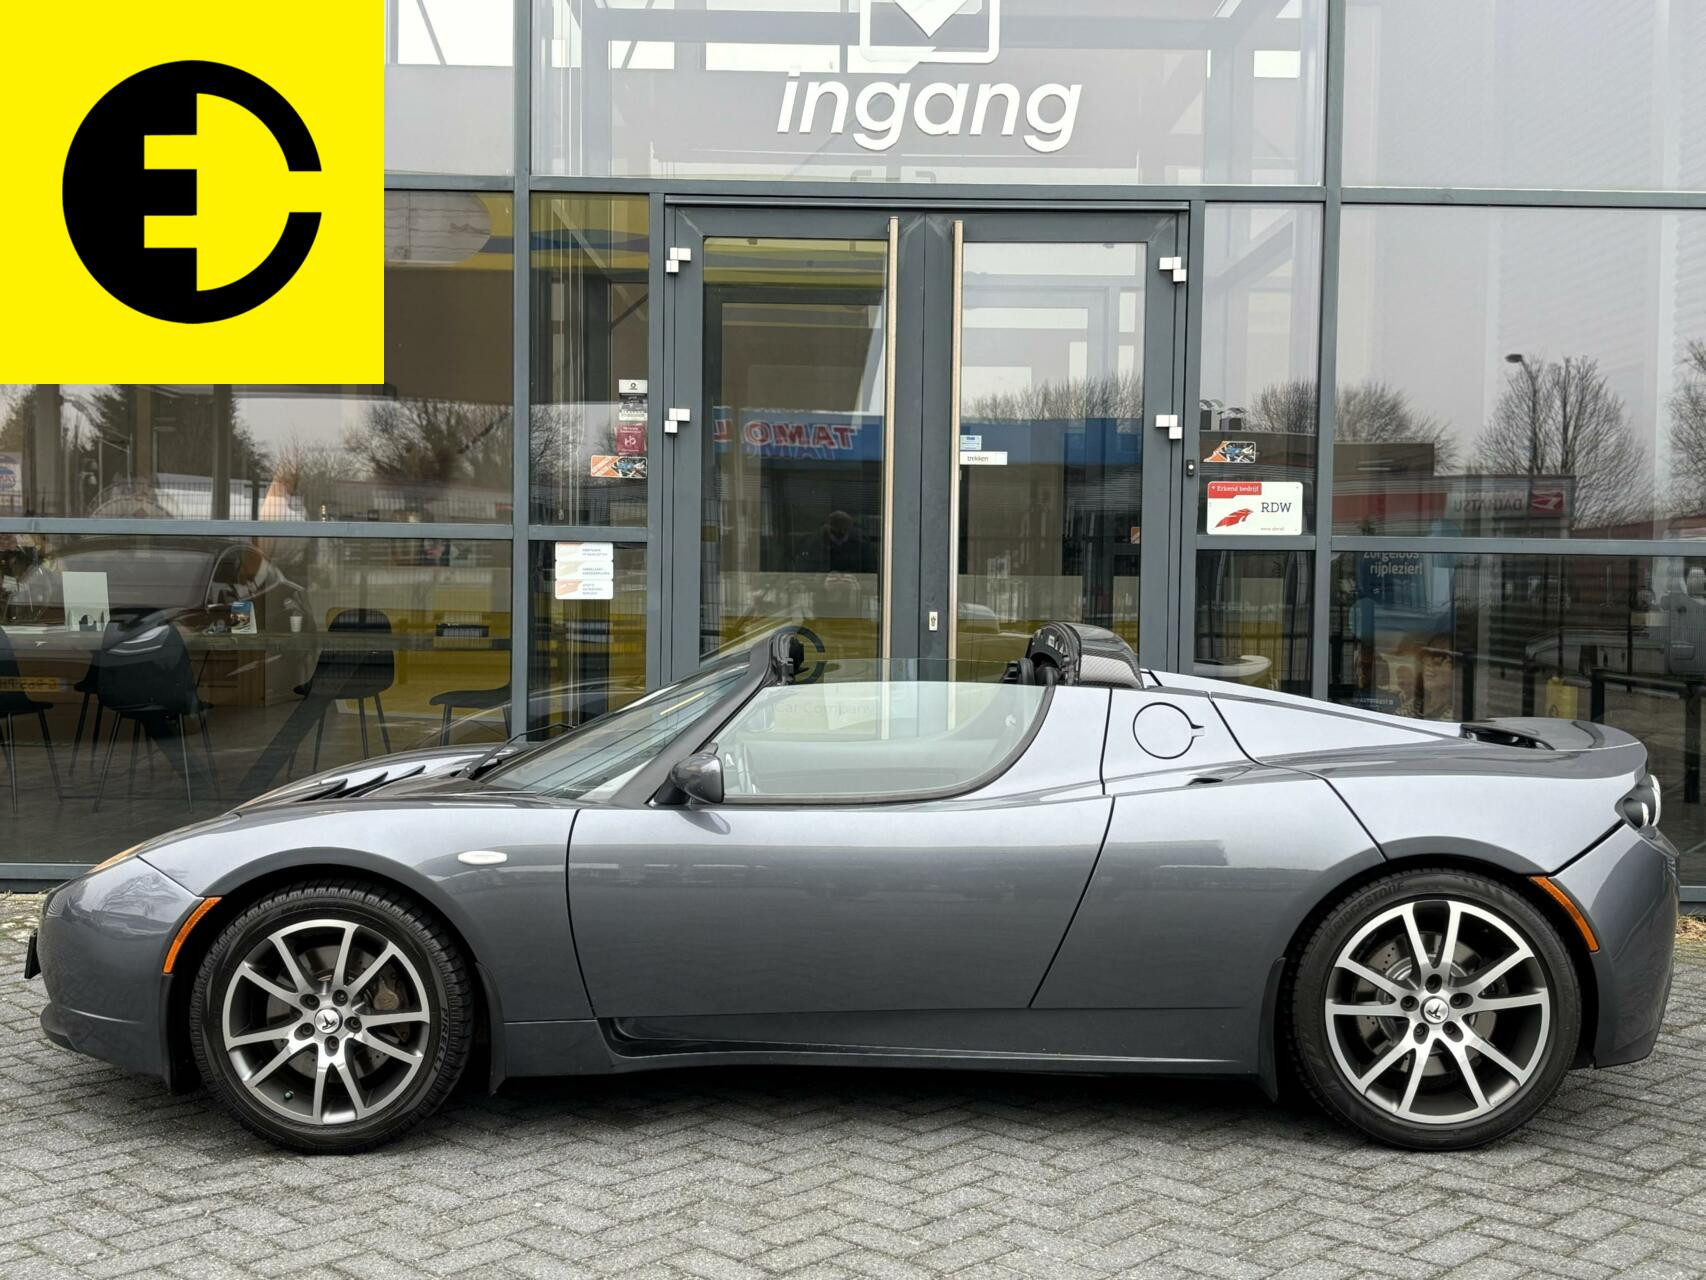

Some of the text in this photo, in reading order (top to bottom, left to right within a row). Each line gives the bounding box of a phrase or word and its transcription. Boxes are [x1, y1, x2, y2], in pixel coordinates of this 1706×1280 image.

[777, 69, 1083, 152] ingang
[1240, 485, 1259, 493] bedrijf
[1261, 502, 1292, 513] RDW
[1370, 561, 1423, 577] rijplezier!
[433, 1007, 448, 1072] PIRELLI
